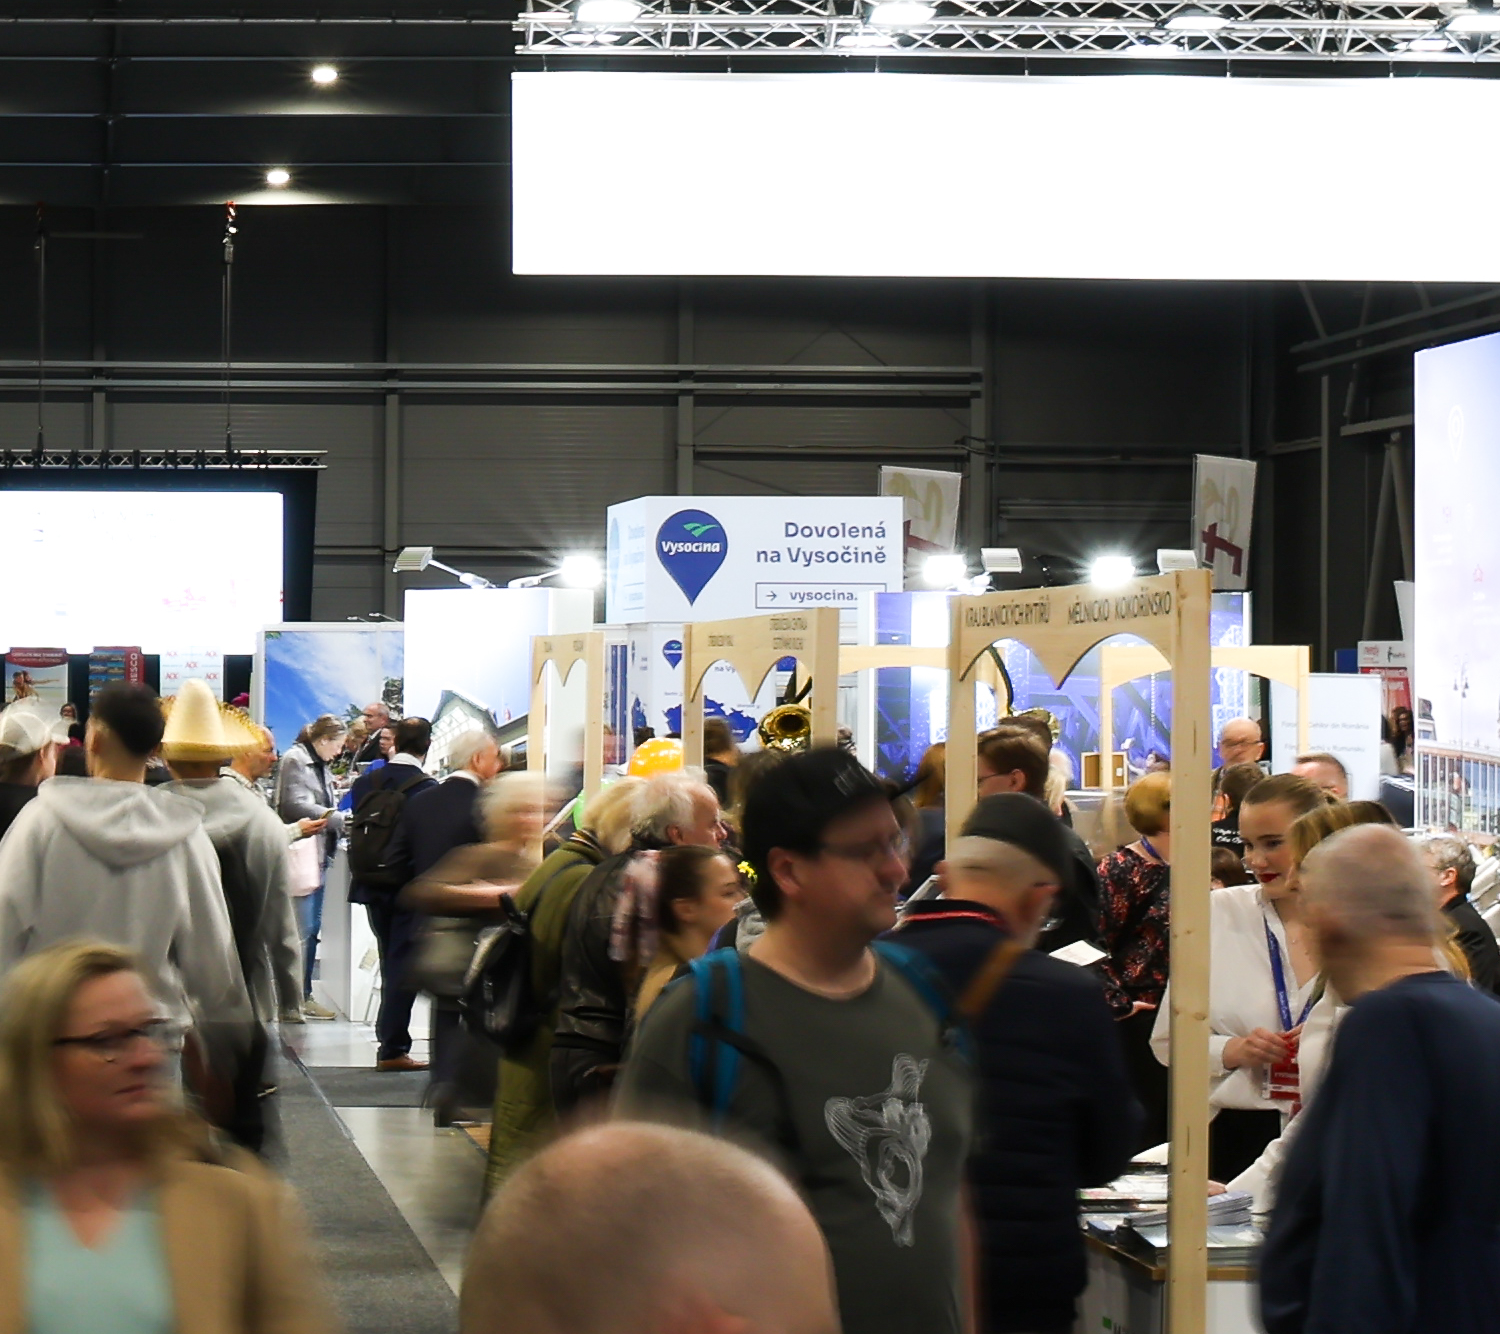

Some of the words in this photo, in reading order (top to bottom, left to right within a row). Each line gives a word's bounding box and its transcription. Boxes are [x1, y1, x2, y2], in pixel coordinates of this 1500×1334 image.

[784, 521, 887, 539] Dovolená
[756, 550, 781, 564] na
[788, 546, 887, 567] Vysočině
[789, 589, 858, 604] vysocina.
[1067, 594, 1110, 625] MĚLNICKO
[1115, 586, 1172, 620] KOKOŘÍNSKO
